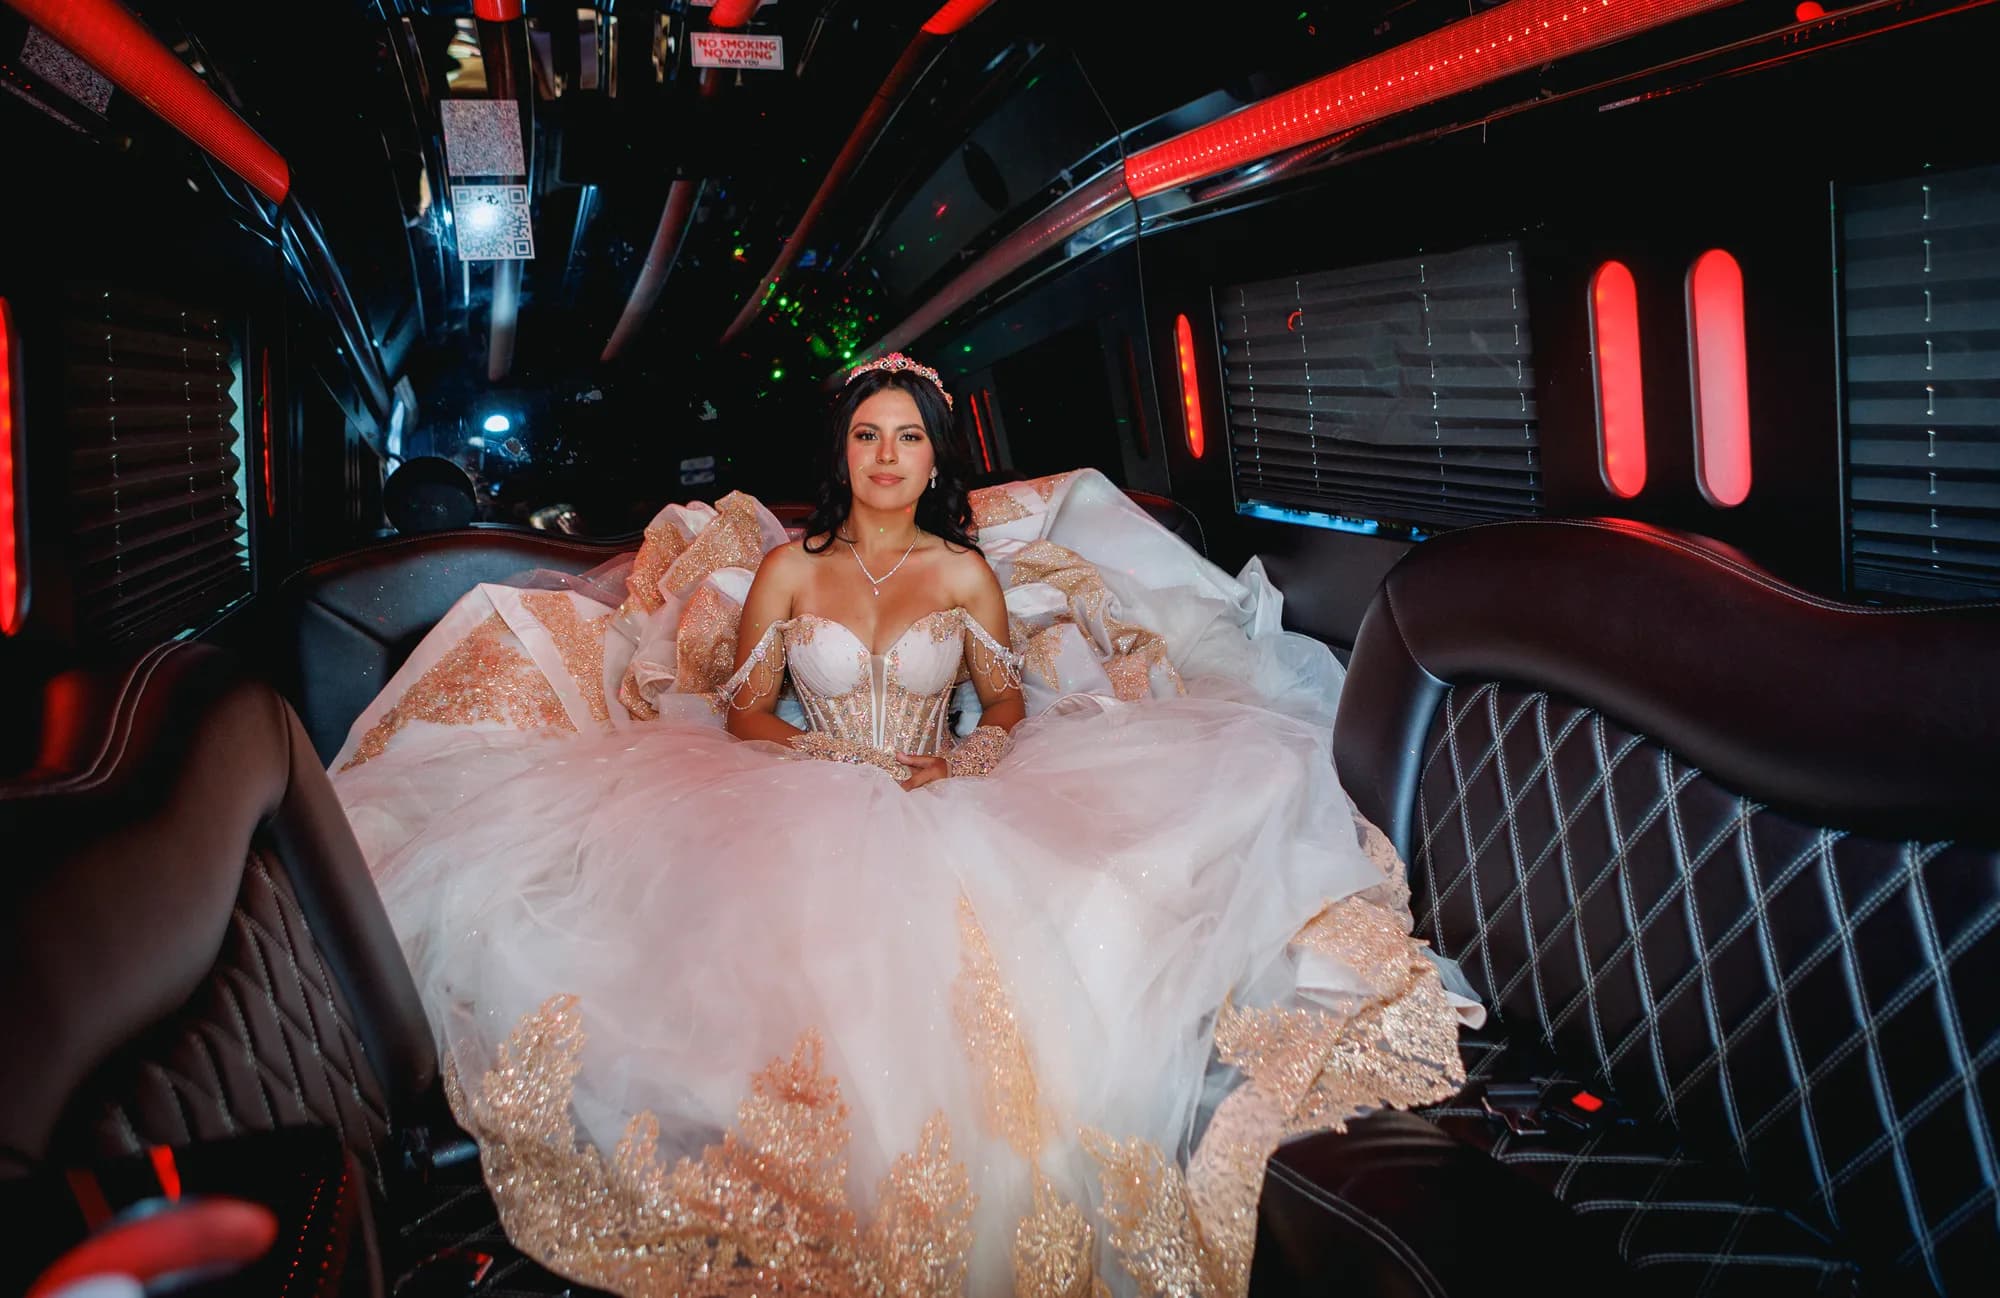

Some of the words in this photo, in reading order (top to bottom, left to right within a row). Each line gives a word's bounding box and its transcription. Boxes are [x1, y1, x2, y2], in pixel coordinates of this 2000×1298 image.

[697, 38, 717, 48] NO
[720, 39, 777, 51] SMOKING
[704, 48, 723, 58] NO
[726, 49, 773, 61] VAPING
